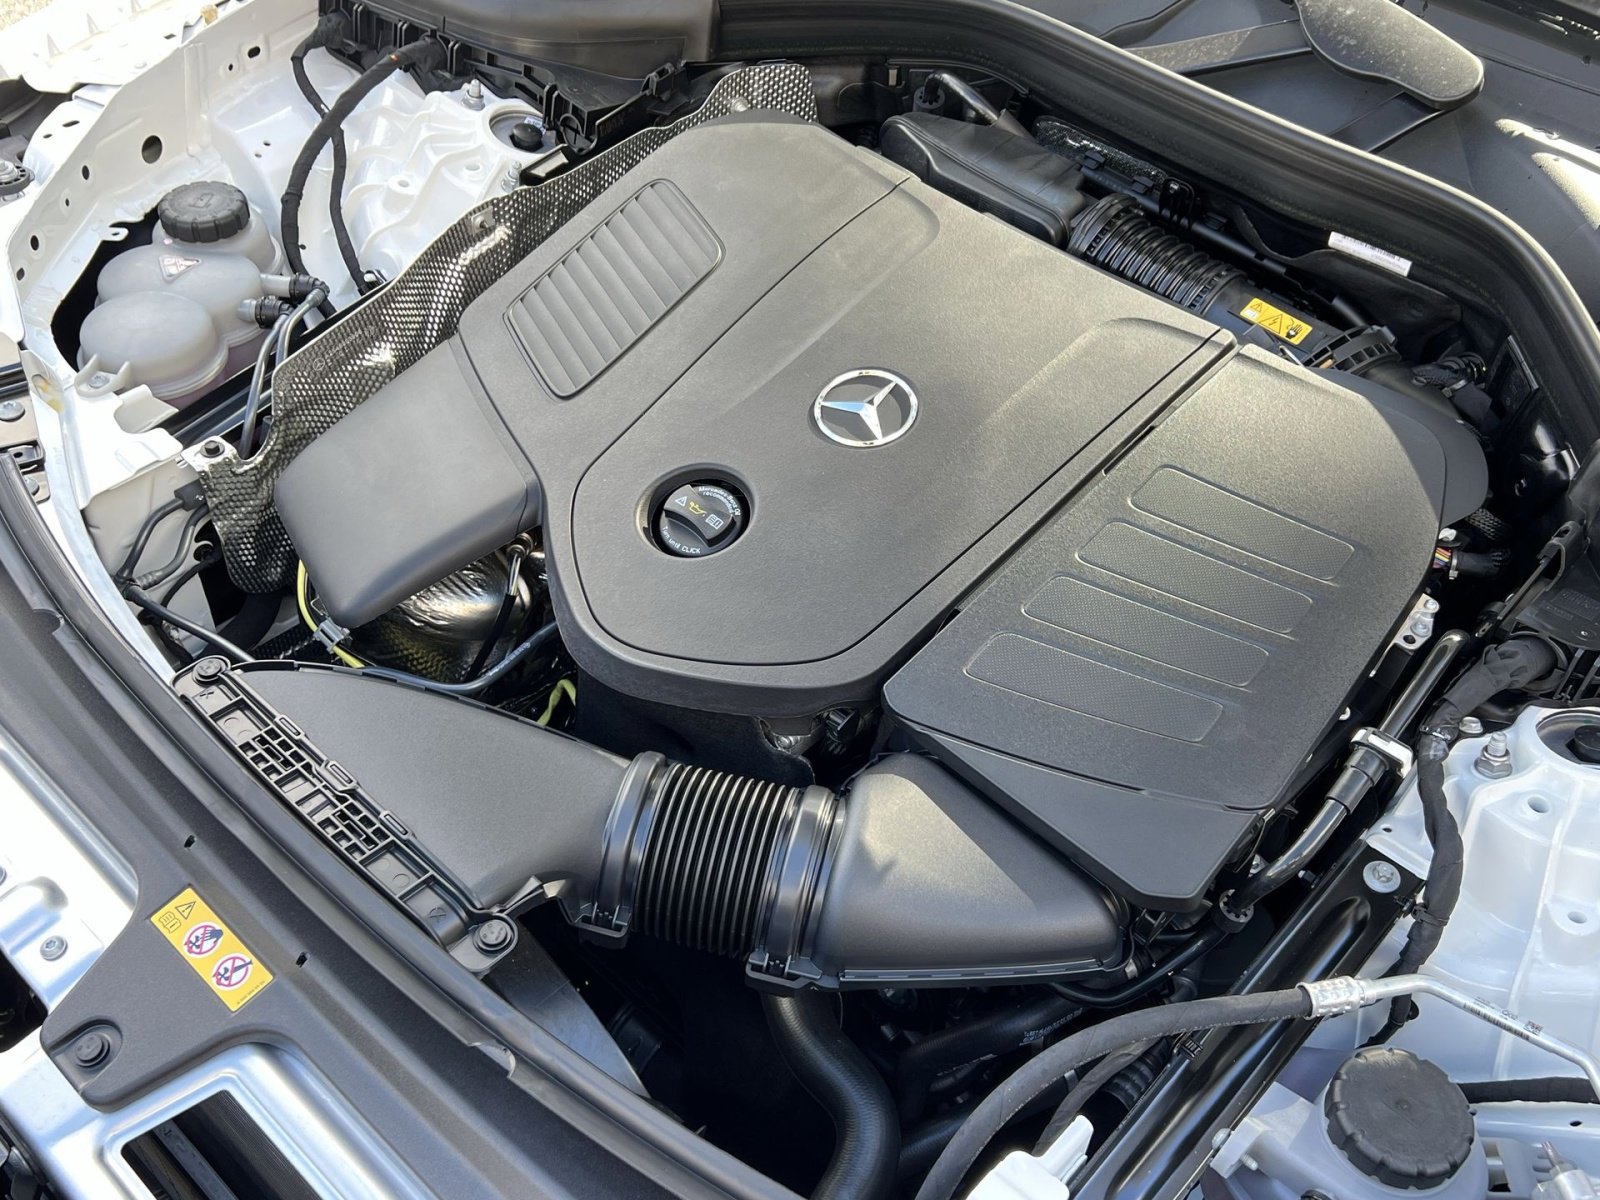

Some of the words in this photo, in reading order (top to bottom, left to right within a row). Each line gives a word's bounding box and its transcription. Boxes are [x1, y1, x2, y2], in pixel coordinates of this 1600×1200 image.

[662, 525, 670, 538] Turn
[668, 538, 681, 549] until
[681, 545, 701, 554] CLICK
